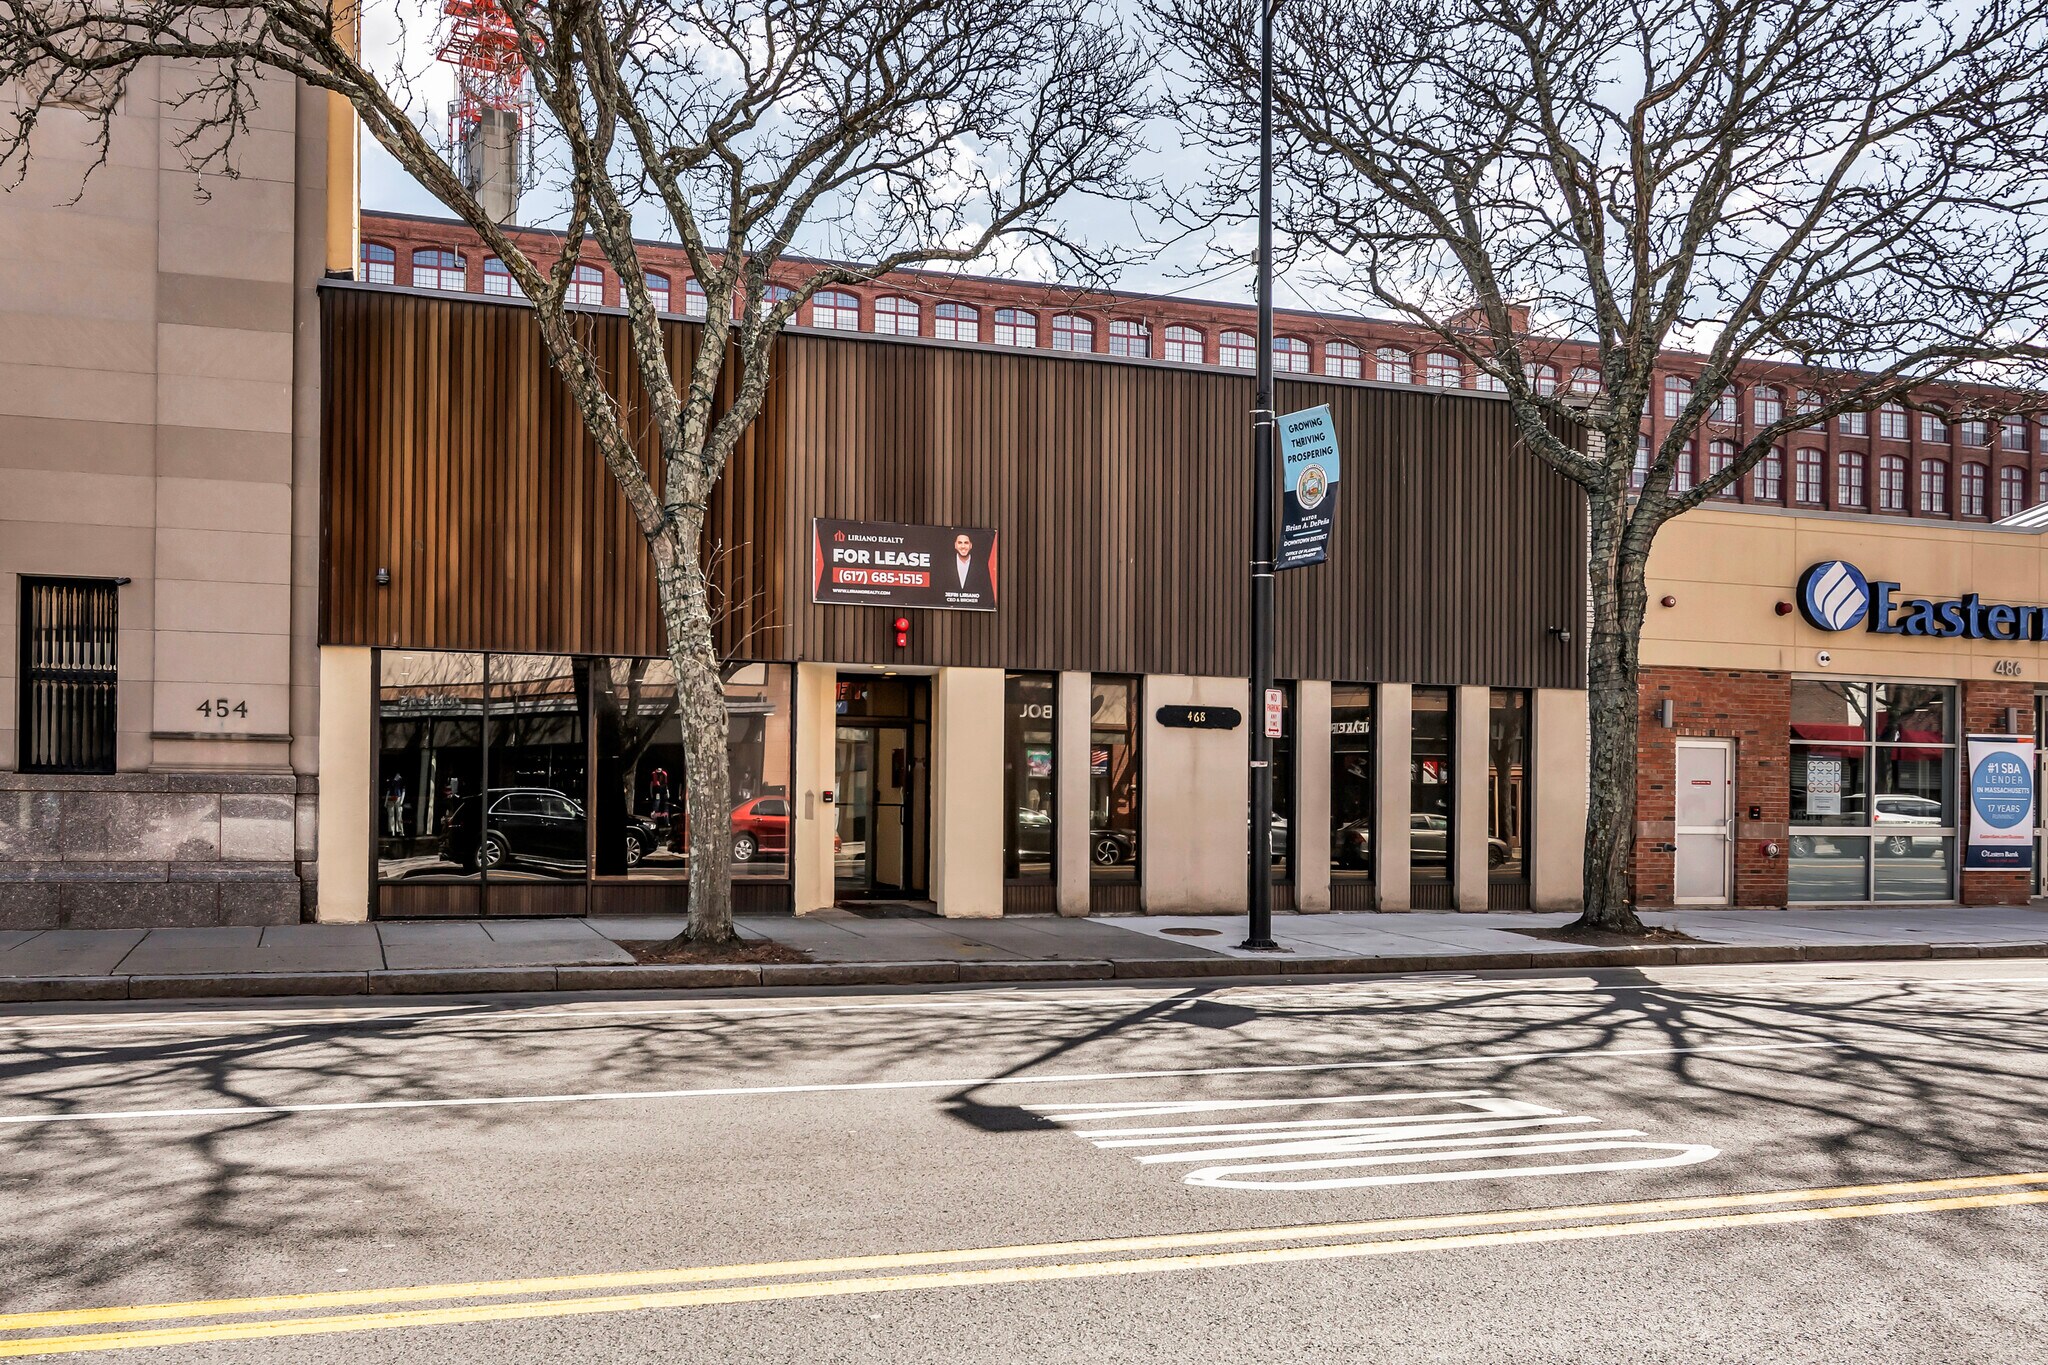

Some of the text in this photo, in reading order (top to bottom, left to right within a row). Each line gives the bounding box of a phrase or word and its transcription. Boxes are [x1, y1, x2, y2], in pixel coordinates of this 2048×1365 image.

[1288, 417, 1323, 433] GROWING
[1291, 432, 1326, 448] THRIVING
[1287, 446, 1333, 464] PROSPERING
[1301, 514, 1317, 522] MAYOR
[1285, 524, 1302, 532] Brian
[848, 534, 904, 544] LIRIANO REALTY
[1283, 537, 1310, 547] DOWNTOWN
[833, 548, 930, 567] FOR LEASE
[839, 569, 923, 585] (617) 685-1515
[1868, 581, 2048, 642] Easter
[1993, 660, 2022, 676] 486
[1270, 693, 1278, 702] NO
[196, 699, 248, 718] 454
[1266, 703, 1281, 712] PARKING
[1187, 711, 1206, 722] 468
[1808, 761, 1840, 772] GOOD
[1987, 762, 2021, 774] #1 SBA
[1985, 775, 2023, 784] LENDER
[1808, 782, 1840, 793] GOOD
[1987, 804, 2020, 812] 17 YEARS
